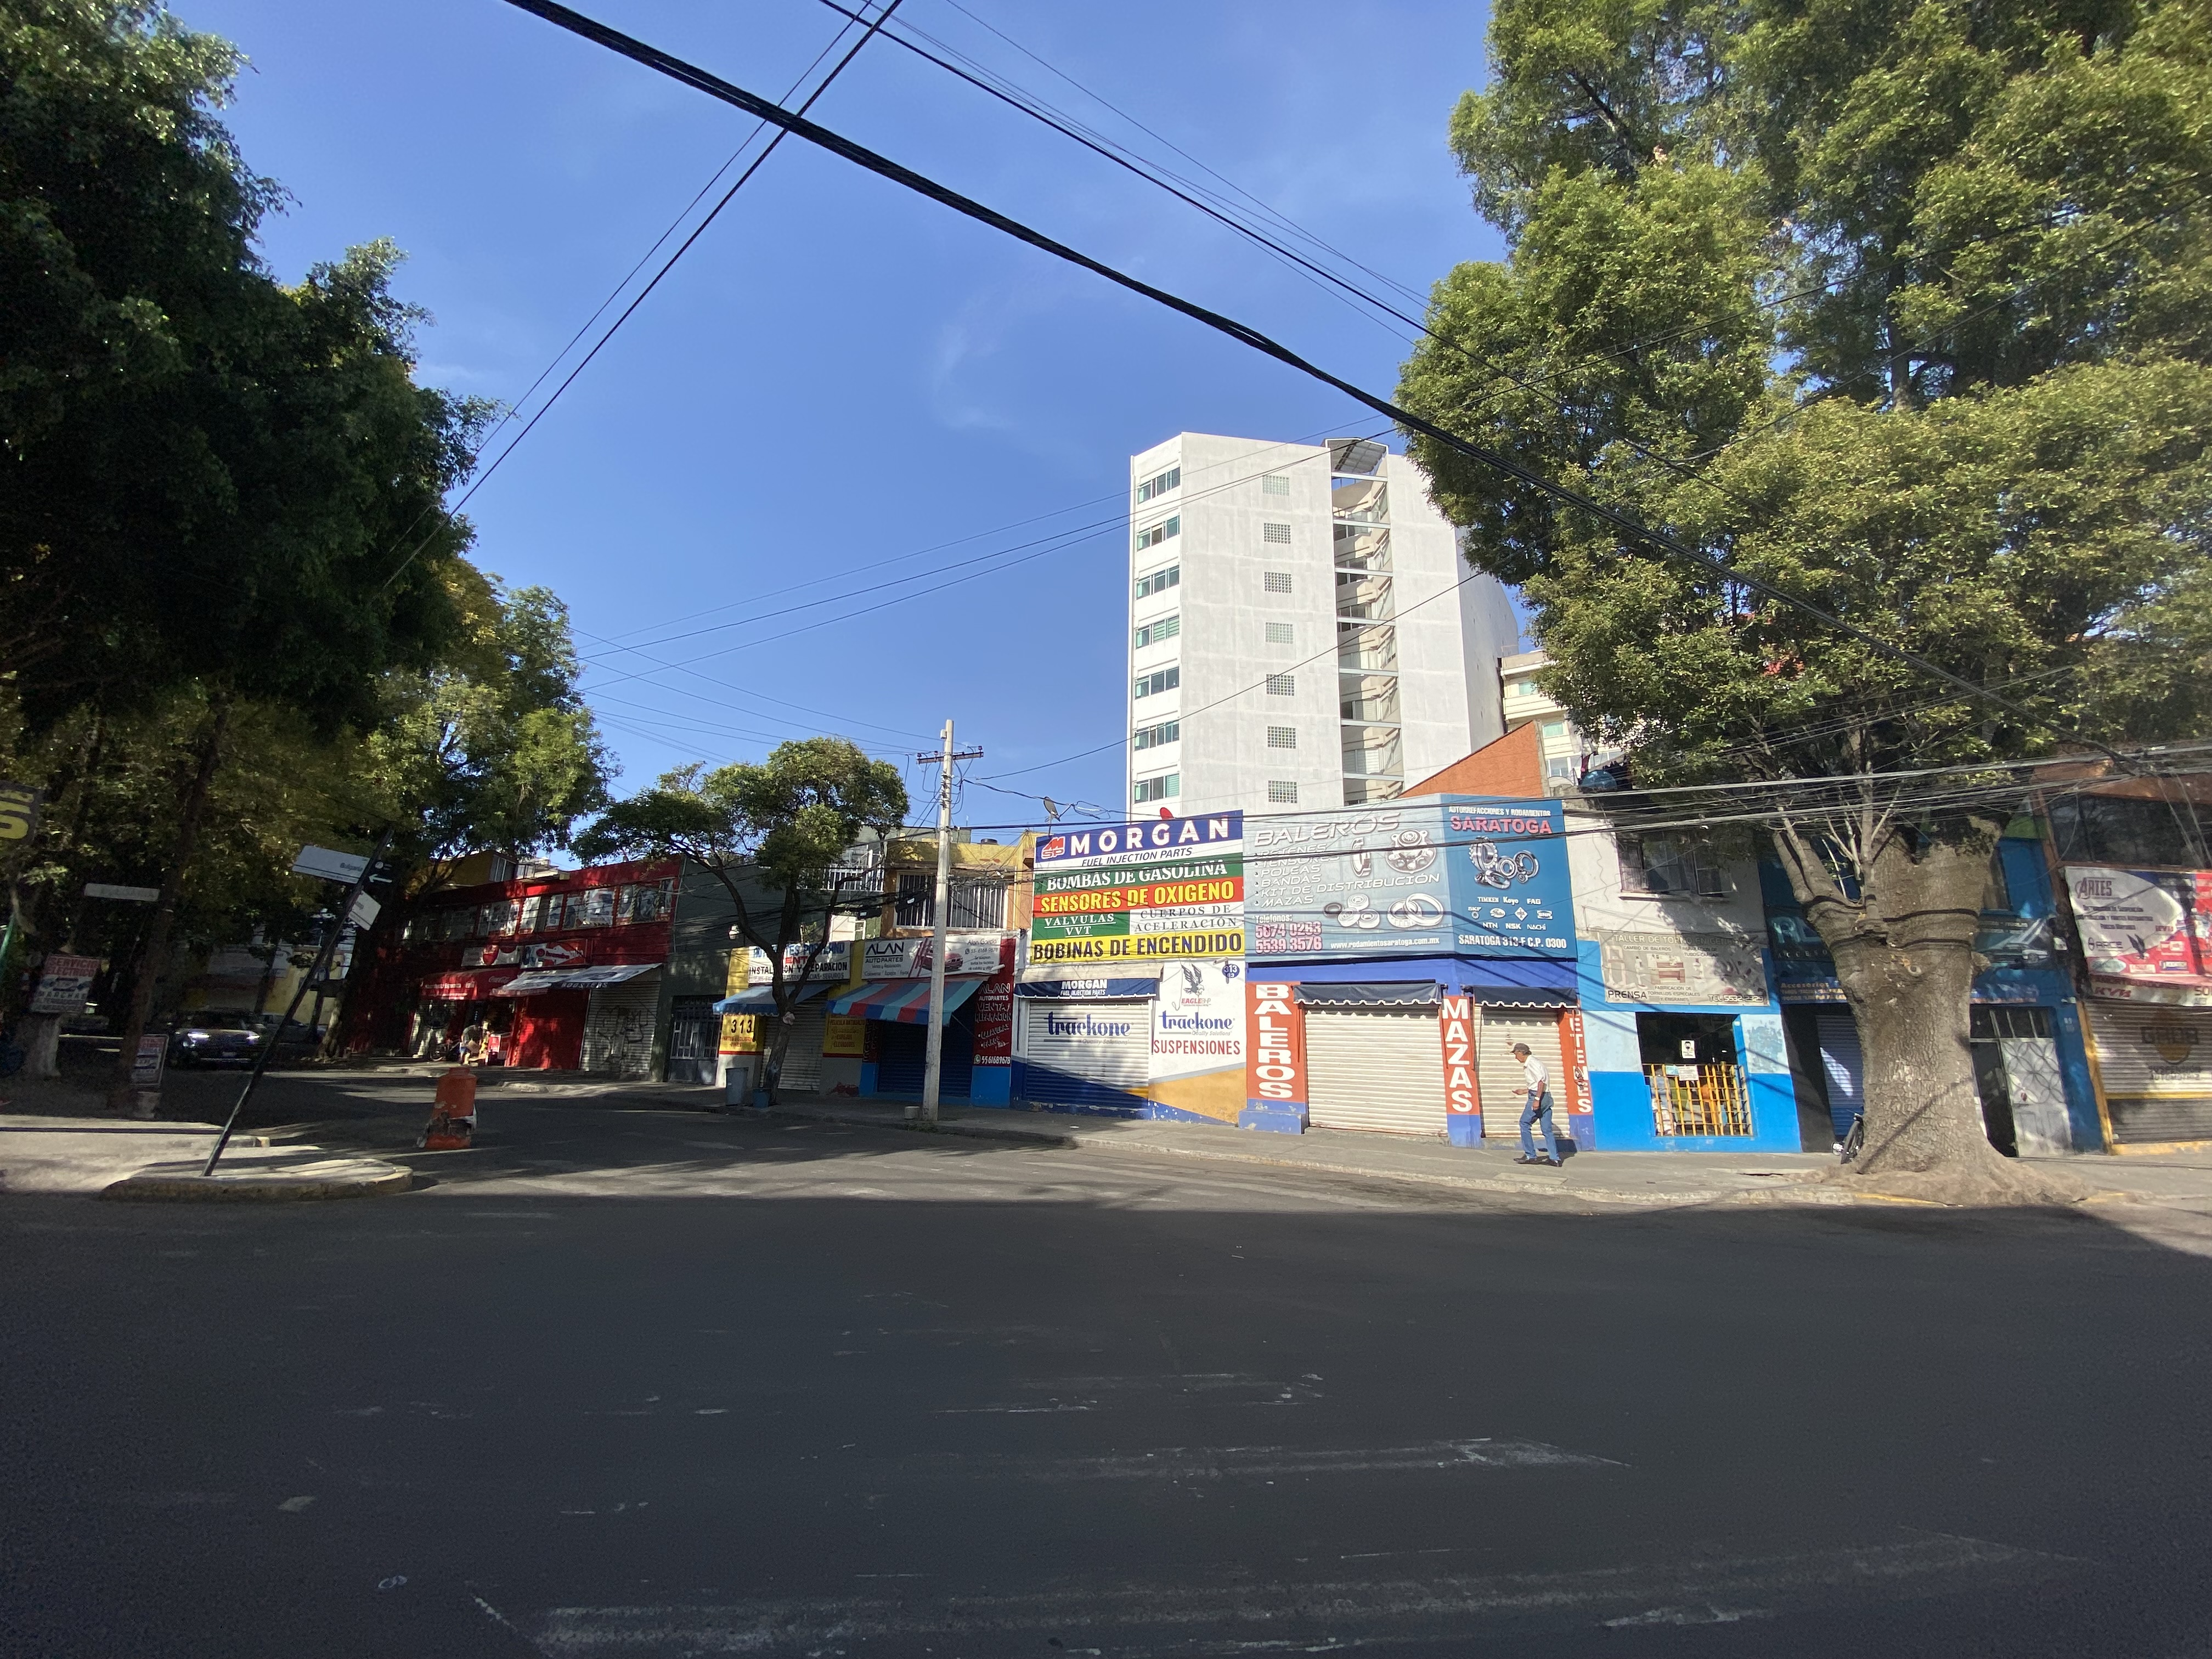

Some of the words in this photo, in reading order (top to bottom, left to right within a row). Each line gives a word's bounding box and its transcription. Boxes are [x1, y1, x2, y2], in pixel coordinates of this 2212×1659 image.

[1449, 806, 1504, 816] AUTORREFACCIONES
[1255, 812, 1401, 847] BALEROS
[1450, 816, 1553, 834] SARATOGA
[1071, 815, 1228, 856] MORGAN
[1082, 857, 1103, 866] FUEL
[1107, 853, 1156, 865] INJECTION
[1160, 848, 1192, 859] PARTS
[1047, 872, 1110, 891] BOMBAS
[1113, 868, 1135, 885] DE
[1139, 860, 1227, 882] GASOLINA
[1261, 864, 1322, 878] POLEAS
[1261, 874, 1322, 888] BANDAS
[1261, 888, 1289, 898] KIT
[1291, 887, 1311, 895] DE
[1316, 873, 1440, 893] DISTRIBUCIÓN
[2075, 877, 2112, 899] ARIES
[1041, 890, 1121, 913] SENSORES
[1128, 886, 1148, 906] DE
[1154, 881, 1234, 905] OXIGENO
[1261, 895, 1314, 907] MAZAS
[1503, 896, 1519, 905] Koyo
[1141, 907, 1205, 918] CUERPOS
[1212, 905, 1231, 914] DE
[1045, 913, 1114, 927] VALVULAS
[1065, 926, 1092, 935] VVT
[1034, 940, 1104, 960] BOBINAS
[1110, 939, 1131, 957] DE
[1137, 933, 1241, 955] ENCENDIDO
[1255, 938, 1286, 953] 5539
[1289, 936, 1322, 952] 3576
[1459, 935, 1500, 946] SARATOGA
[1503, 936, 1526, 946] 313-F
[1527, 937, 1544, 947] C.P.
[1545, 938, 1567, 949] 0300
[1613, 934, 1645, 943] TALLER
[1662, 935, 1692, 945] TORNO
[866, 941, 904, 955] ALAN
[786, 956, 808, 964] ENT
[749, 964, 793, 975] INSTALON
[797, 964, 803, 973] Y
[811, 962, 848, 972] EPARACION
[1224, 964, 1238, 973] 313
[978, 983, 1010, 994] ALAN
[1061, 979, 1107, 990] MORGAN
[1607, 990, 1647, 1000] PRENSA
[977, 1002, 1006, 1013] VENTA
[731, 1019, 753, 1034] 313
[1044, 1011, 1132, 1036] trackone
[1159, 1011, 1234, 1030] trackone
[1154, 1040, 1241, 1055] SUSPENSIONES
[1255, 984, 1296, 1099] BALEROS
[1442, 998, 1472, 1113] MAZAS
[1570, 1008, 1592, 1113] ETENES
